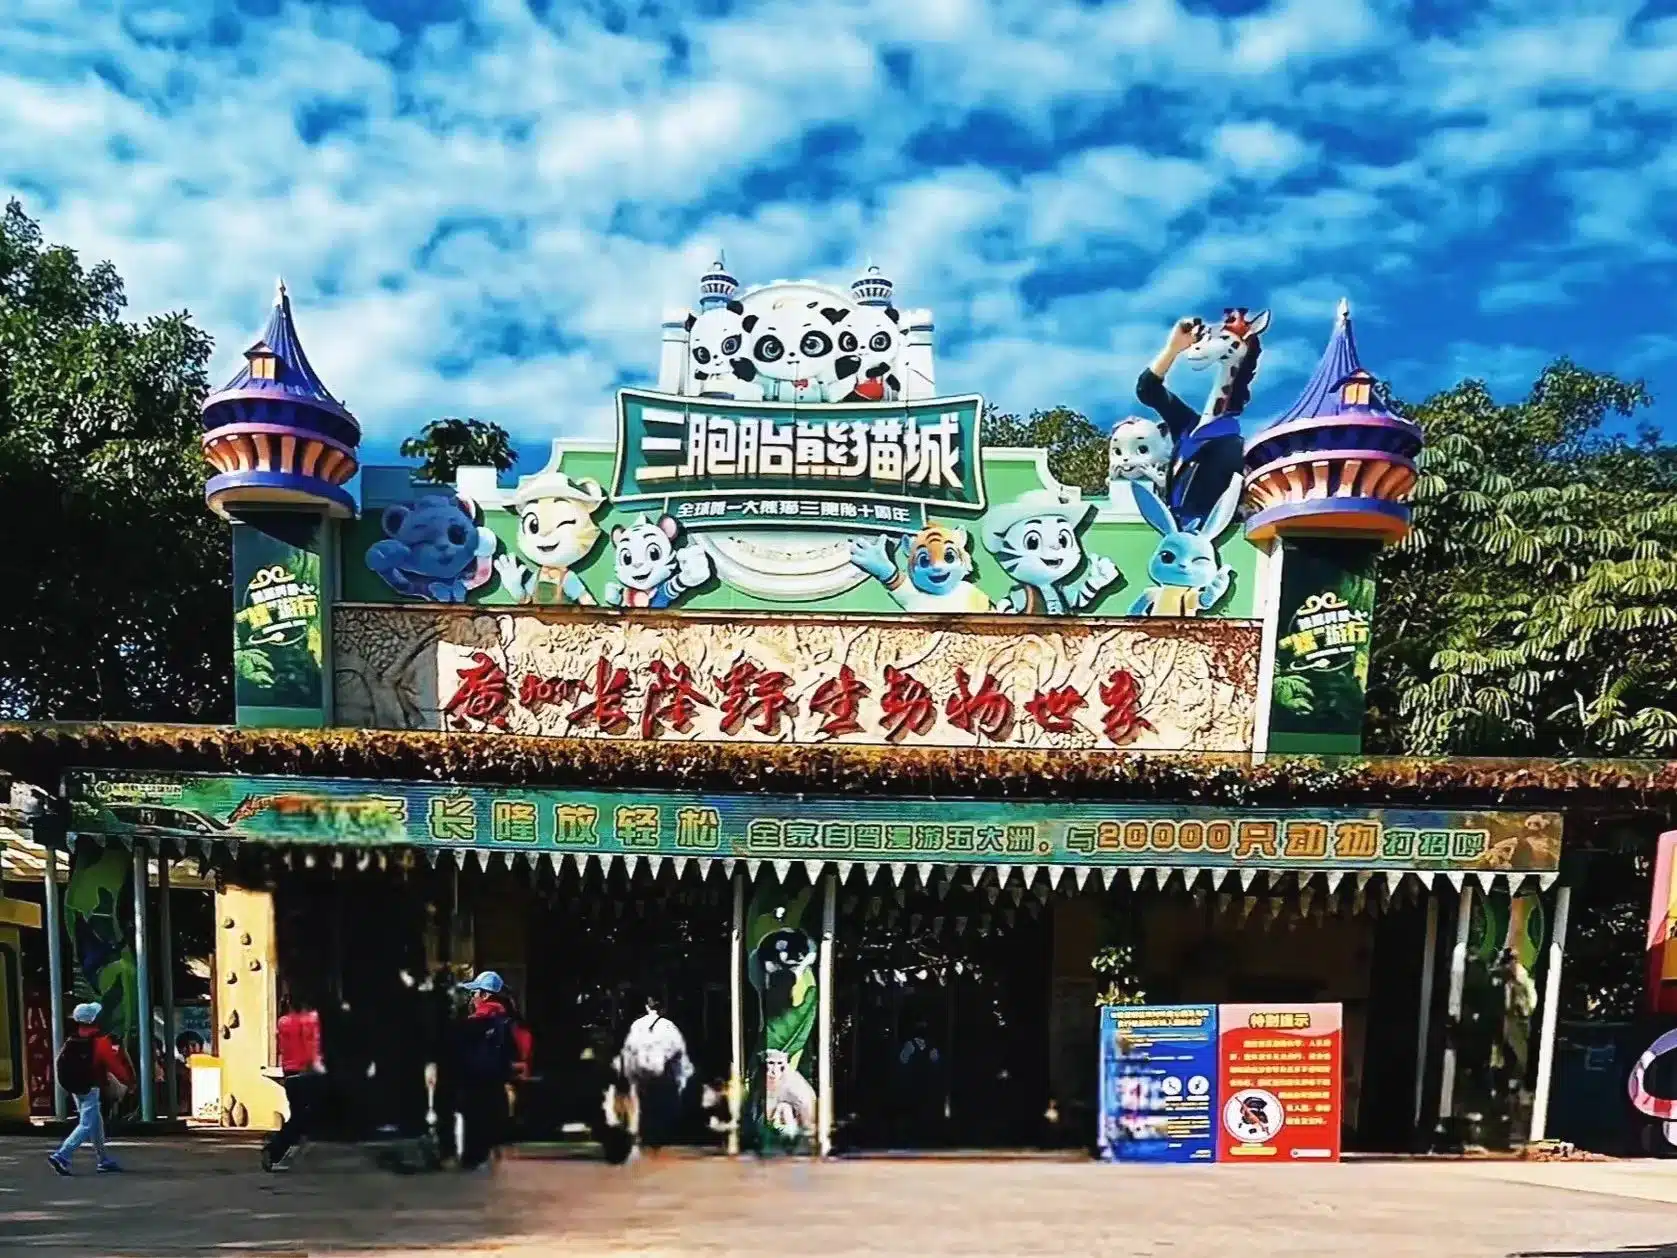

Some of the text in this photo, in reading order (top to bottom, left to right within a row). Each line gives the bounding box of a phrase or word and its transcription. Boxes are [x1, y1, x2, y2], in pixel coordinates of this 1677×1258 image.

[635, 408, 963, 490] 三胞胎熊猫城
